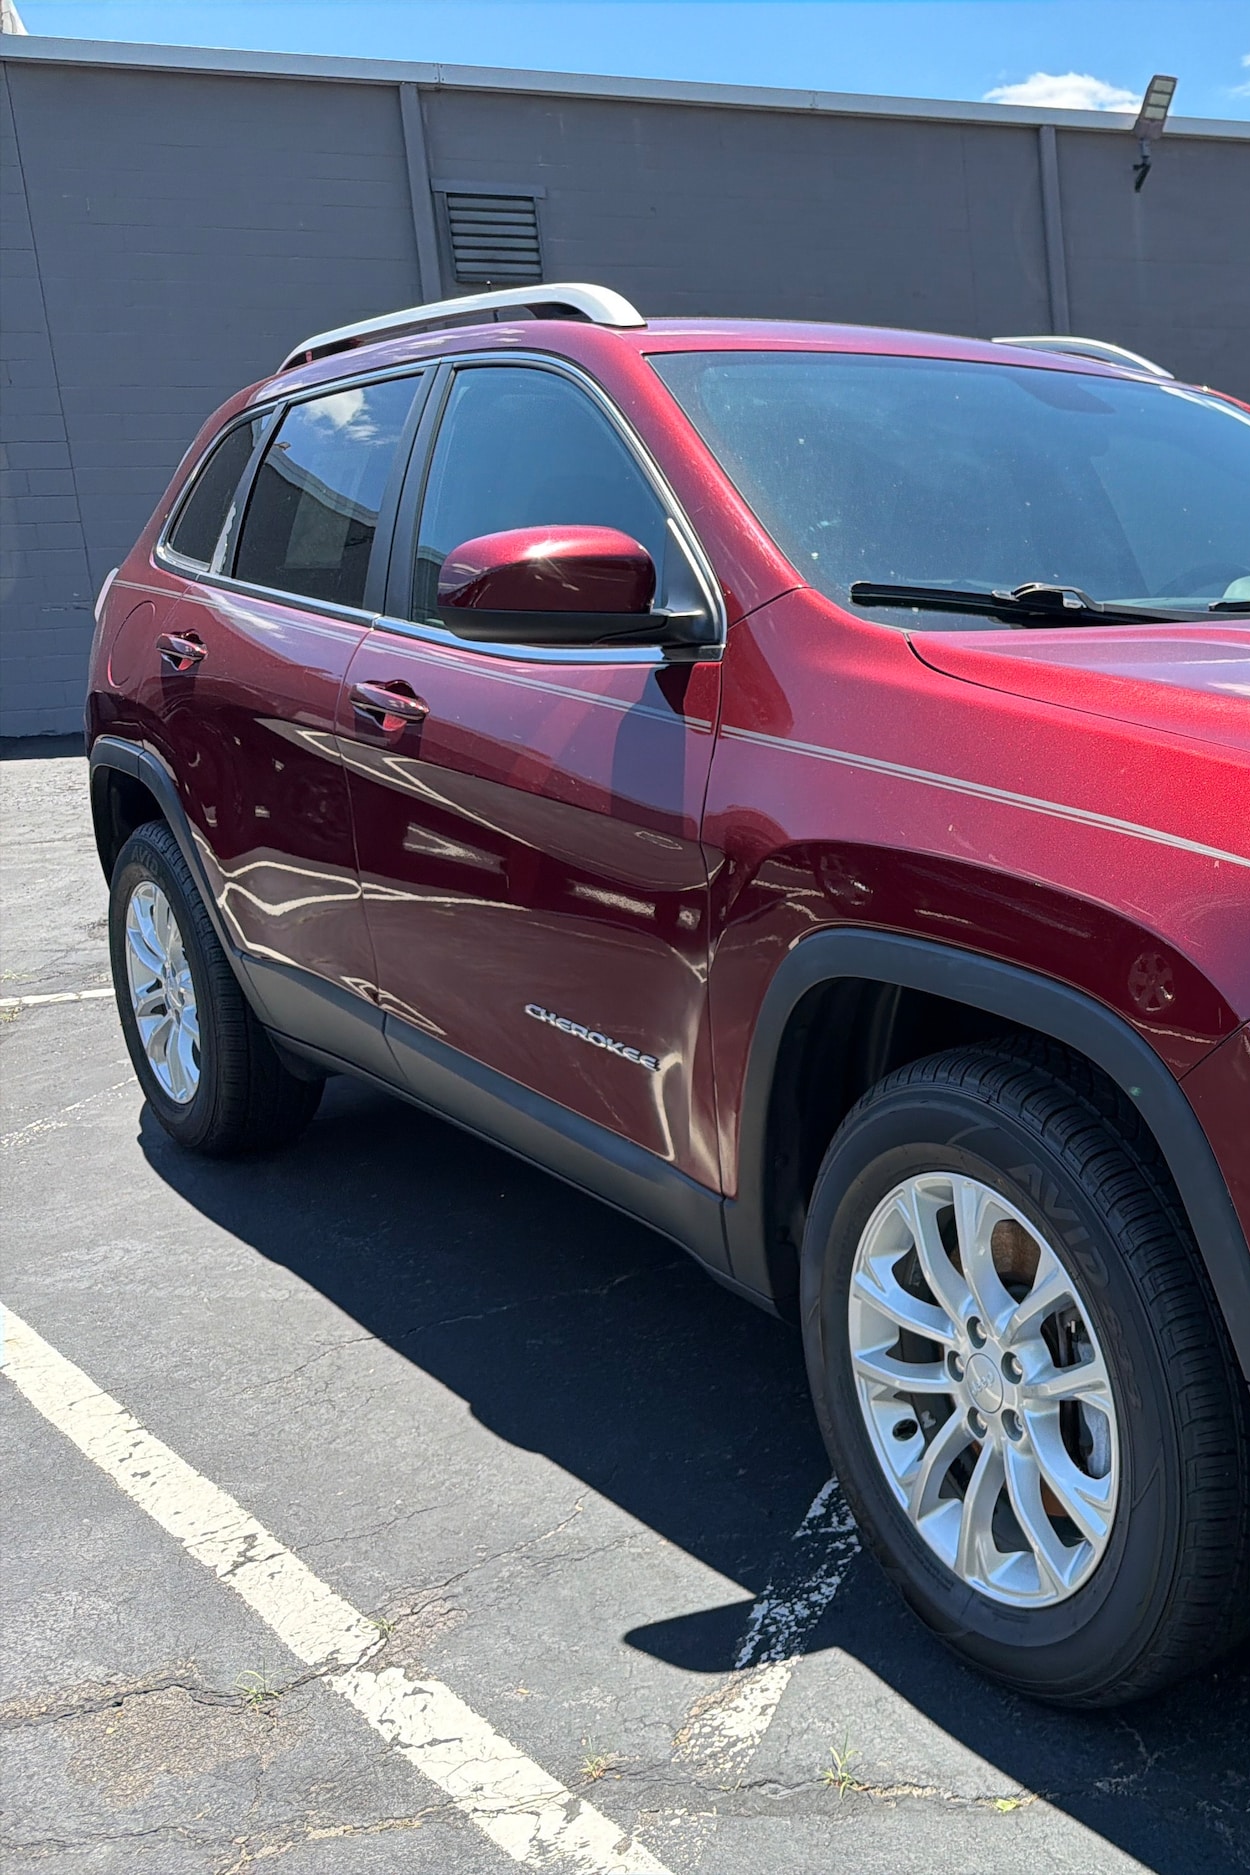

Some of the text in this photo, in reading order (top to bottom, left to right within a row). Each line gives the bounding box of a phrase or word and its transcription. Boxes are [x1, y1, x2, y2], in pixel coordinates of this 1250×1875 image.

[524, 1002, 660, 1071] CHEROKEE
[1006, 1162, 1112, 1289] AVID
[971, 1371, 995, 1397] Jeep
